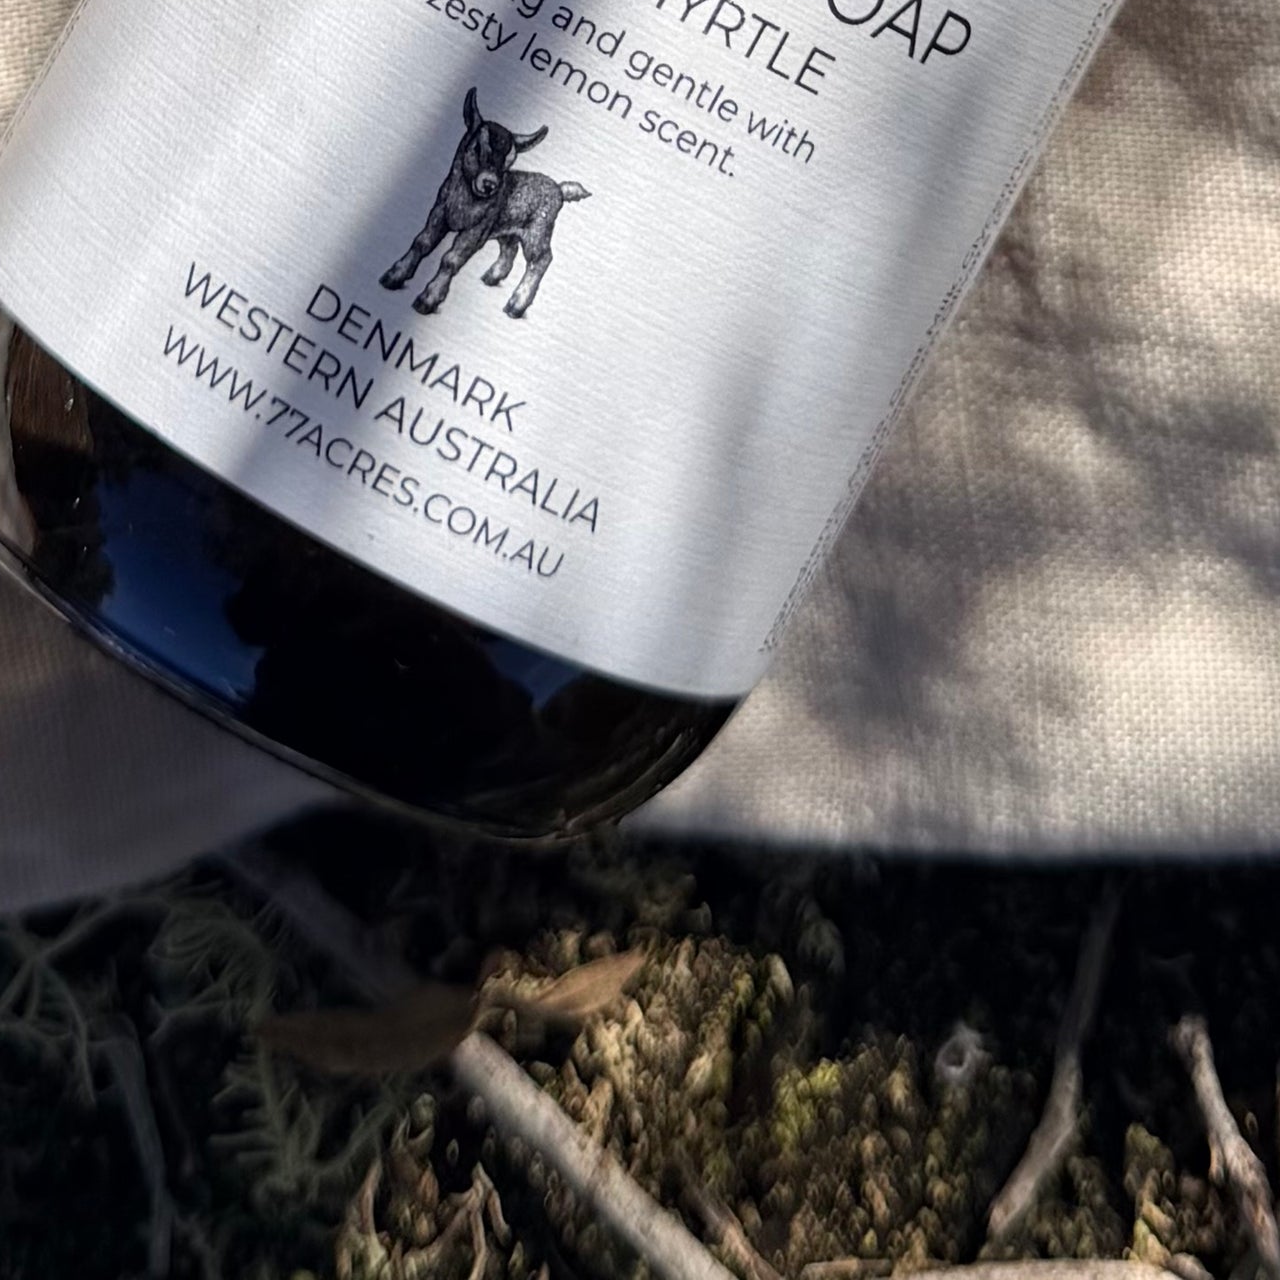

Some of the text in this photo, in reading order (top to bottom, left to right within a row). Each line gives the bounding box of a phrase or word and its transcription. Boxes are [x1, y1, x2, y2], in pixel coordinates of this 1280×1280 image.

[519, 32, 633, 120] lemon
[638, 109, 735, 176] scent.
[551, 5, 627, 59] and
[623, 50, 739, 123] gentle
[747, 111, 815, 164] with
[184, 261, 599, 534] WESTERN AUSTRALIA
[305, 283, 527, 433] DENMARK
[163, 324, 565, 578] WWW.77ACRES.COM.AU
